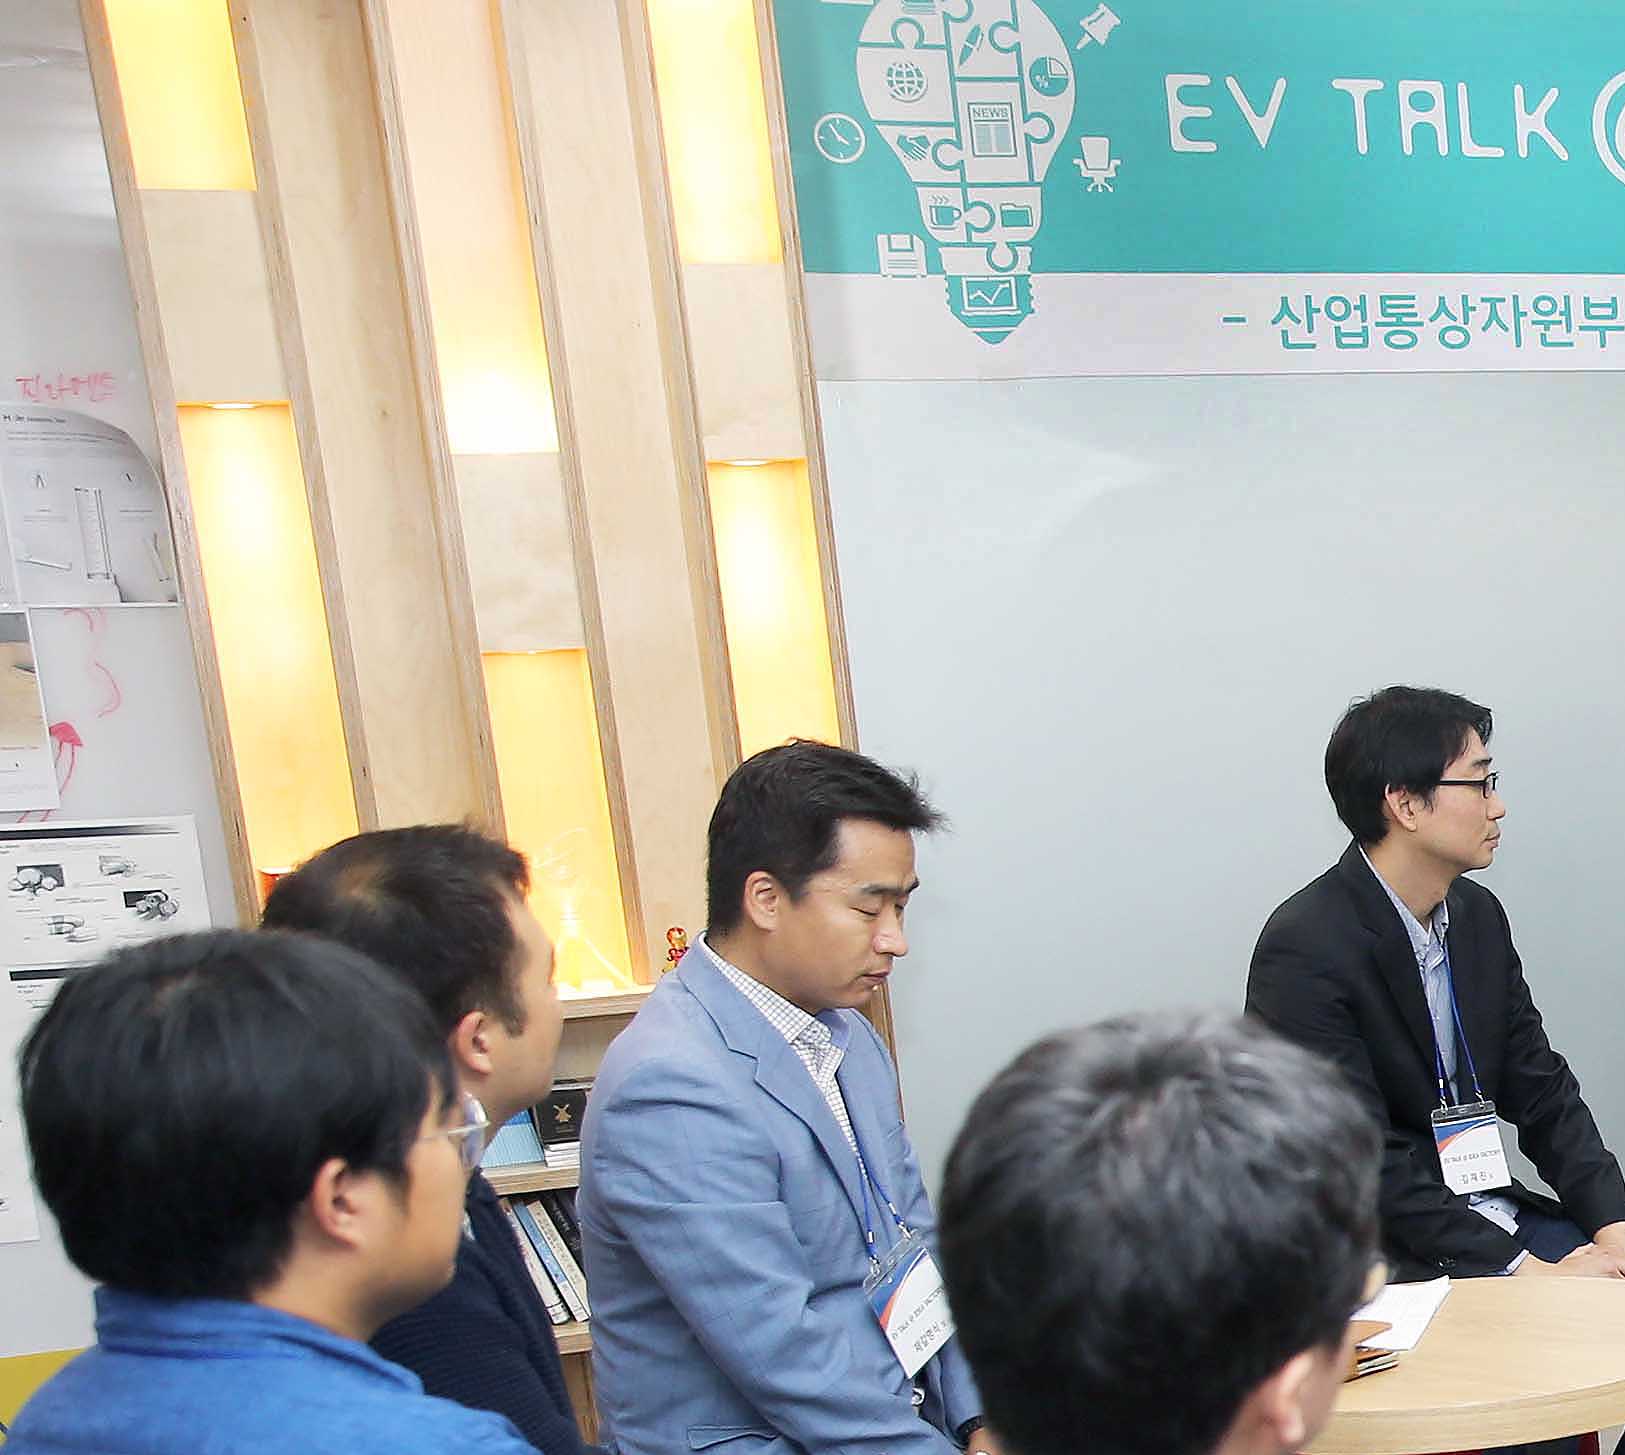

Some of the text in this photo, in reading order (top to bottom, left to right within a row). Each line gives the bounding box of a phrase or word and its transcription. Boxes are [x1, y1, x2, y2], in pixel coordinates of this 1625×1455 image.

[973, 107, 1009, 117] NEWS
[1165, 73, 1288, 153] EV
[1332, 78, 1569, 162] TALK
